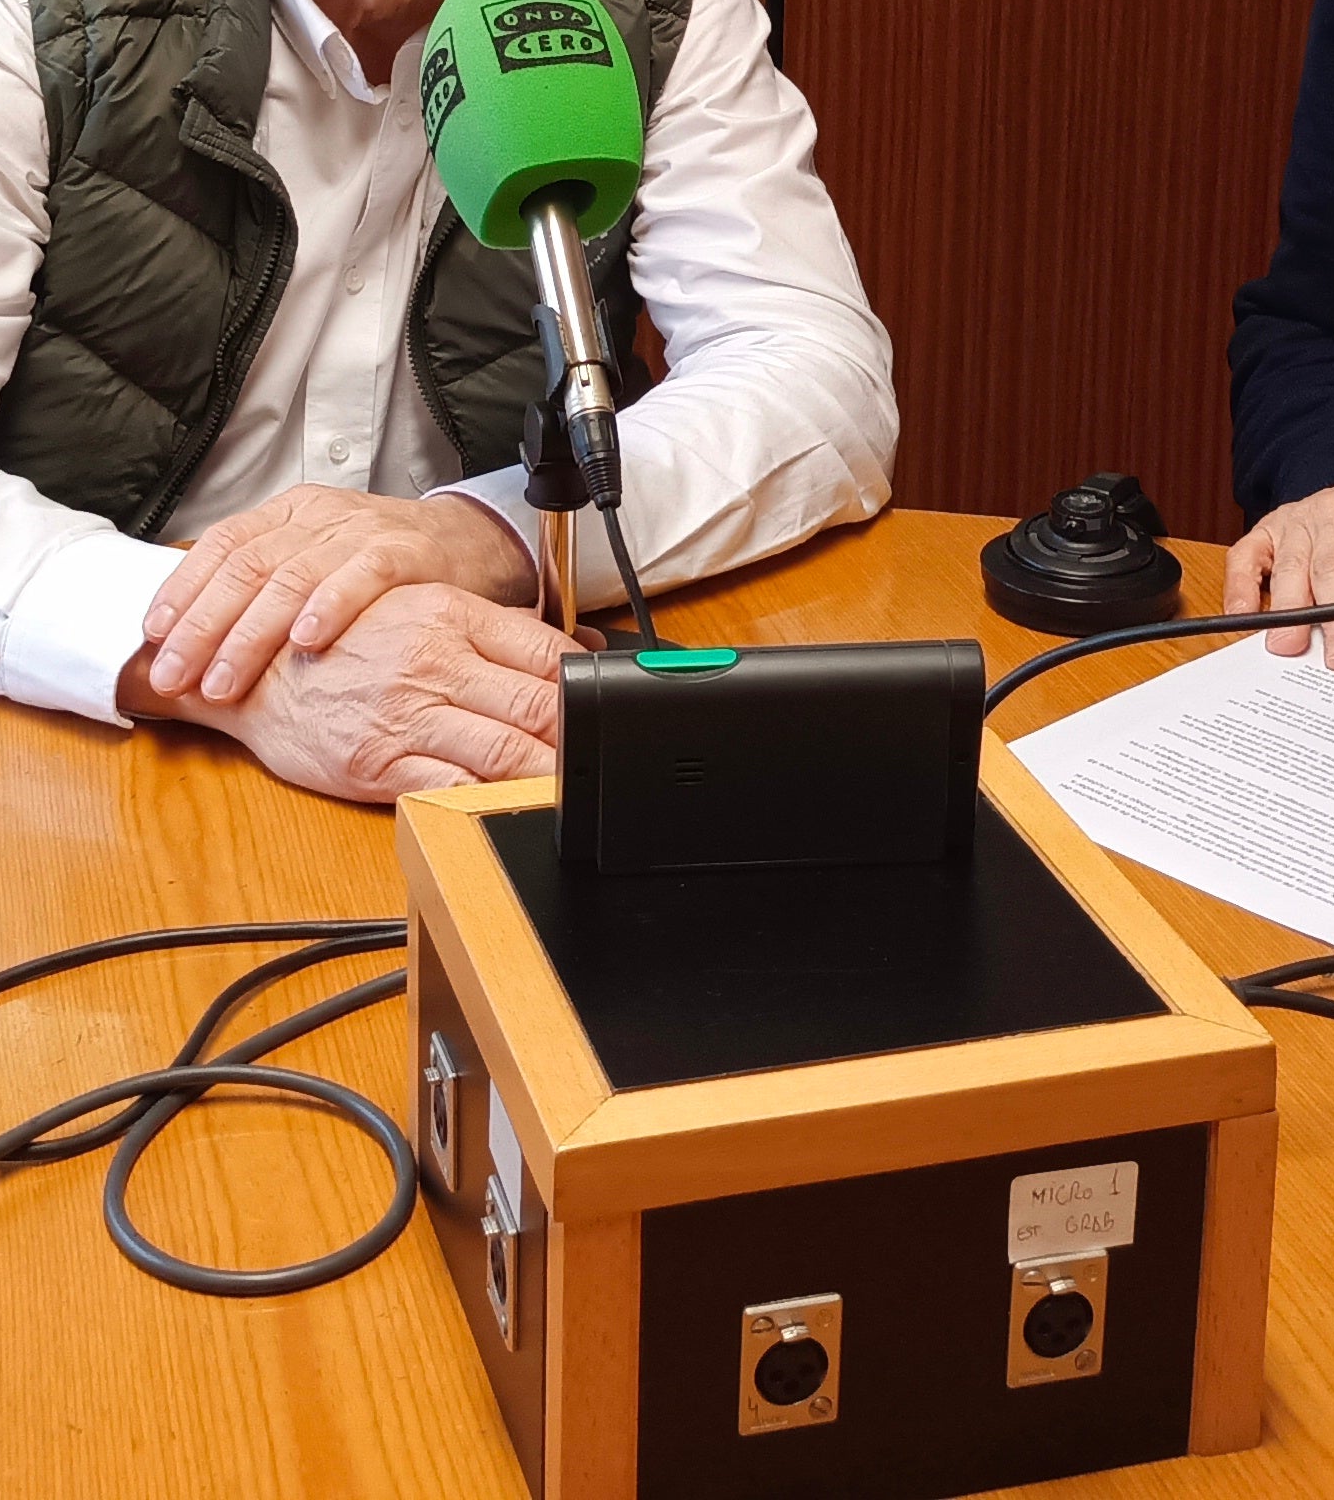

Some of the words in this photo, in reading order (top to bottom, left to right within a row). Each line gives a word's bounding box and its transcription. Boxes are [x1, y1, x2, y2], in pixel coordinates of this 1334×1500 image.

[503, 10, 583, 26] ONDA
[517, 34, 593, 54] CERO
[1032, 1181, 1093, 1206] MICRO
[1109, 1168, 1121, 1195] 1
